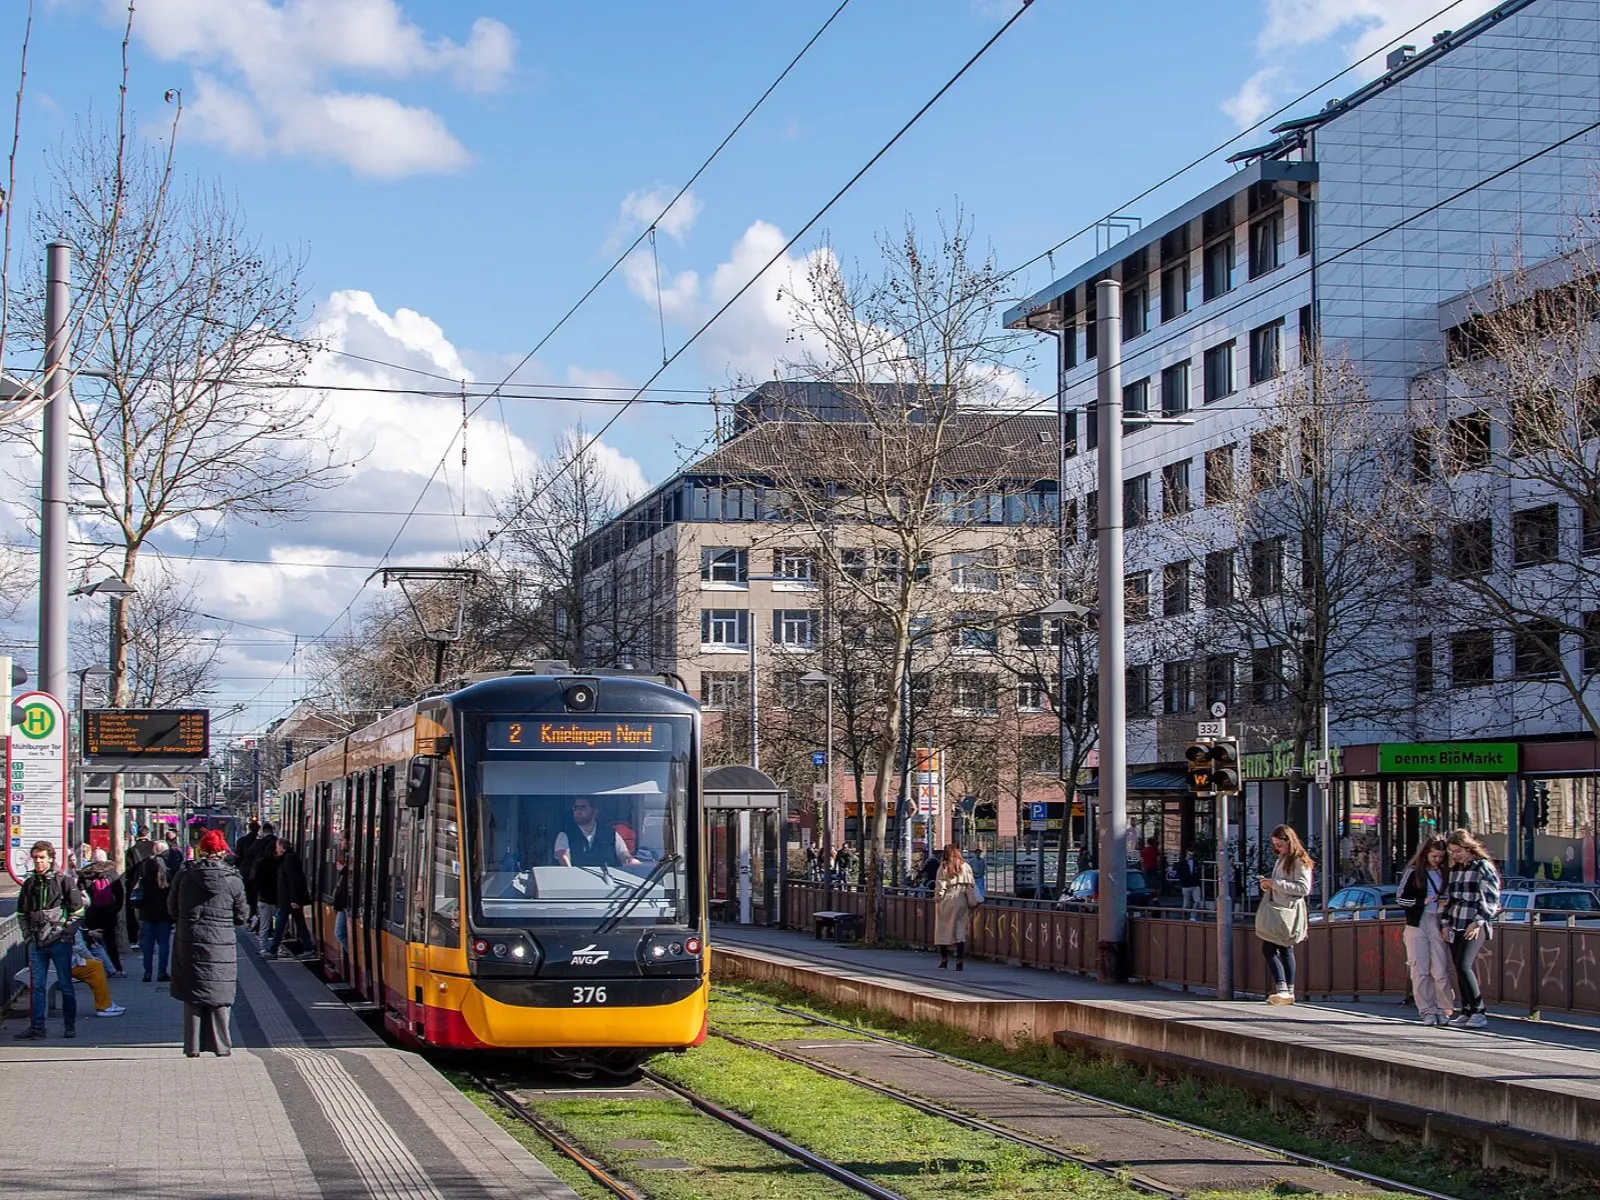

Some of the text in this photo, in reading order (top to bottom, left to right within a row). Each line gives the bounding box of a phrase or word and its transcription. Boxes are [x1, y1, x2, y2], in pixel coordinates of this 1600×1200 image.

[1214, 705, 1223, 713] A
[28, 711, 45, 731] H
[508, 723, 653, 745] 2 Knielingen Nord
[1199, 724, 1219, 734] 332
[1241, 753, 1270, 778] enns
[1317, 761, 1328, 775] H
[1194, 774, 1207, 785] W
[921, 786, 938, 798] XL
[1033, 804, 1043, 819] P
[570, 956, 594, 965] AVG
[572, 986, 607, 1003] 376
